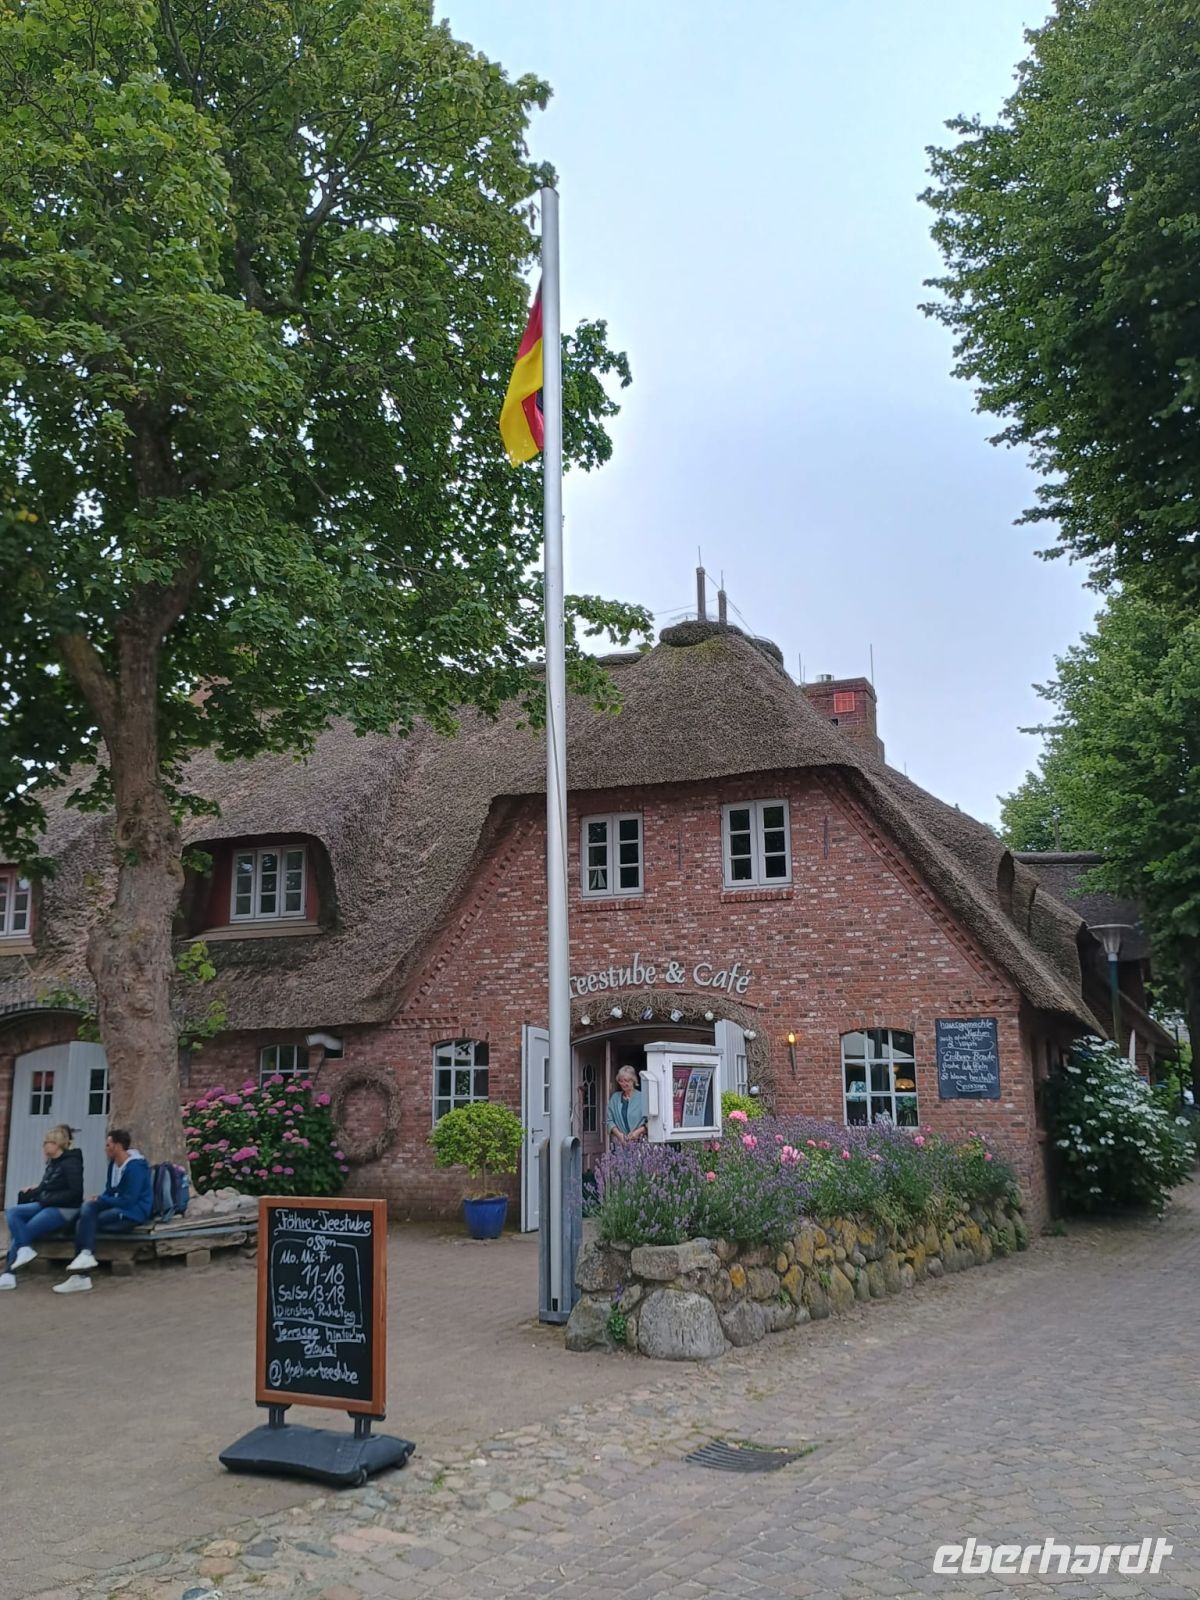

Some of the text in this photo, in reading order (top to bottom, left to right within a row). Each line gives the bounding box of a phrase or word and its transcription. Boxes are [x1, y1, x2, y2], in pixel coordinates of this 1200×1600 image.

[665, 961, 686, 984] &
[693, 962, 750, 994] Café
[275, 1209, 371, 1232] Föhrer Teestube
[301, 1263, 345, 1285] 11-18
[308, 1284, 346, 1305] 13-18
[276, 1302, 356, 1325] Dienstag Ruhetag
[273, 1321, 320, 1341] Terrasse
